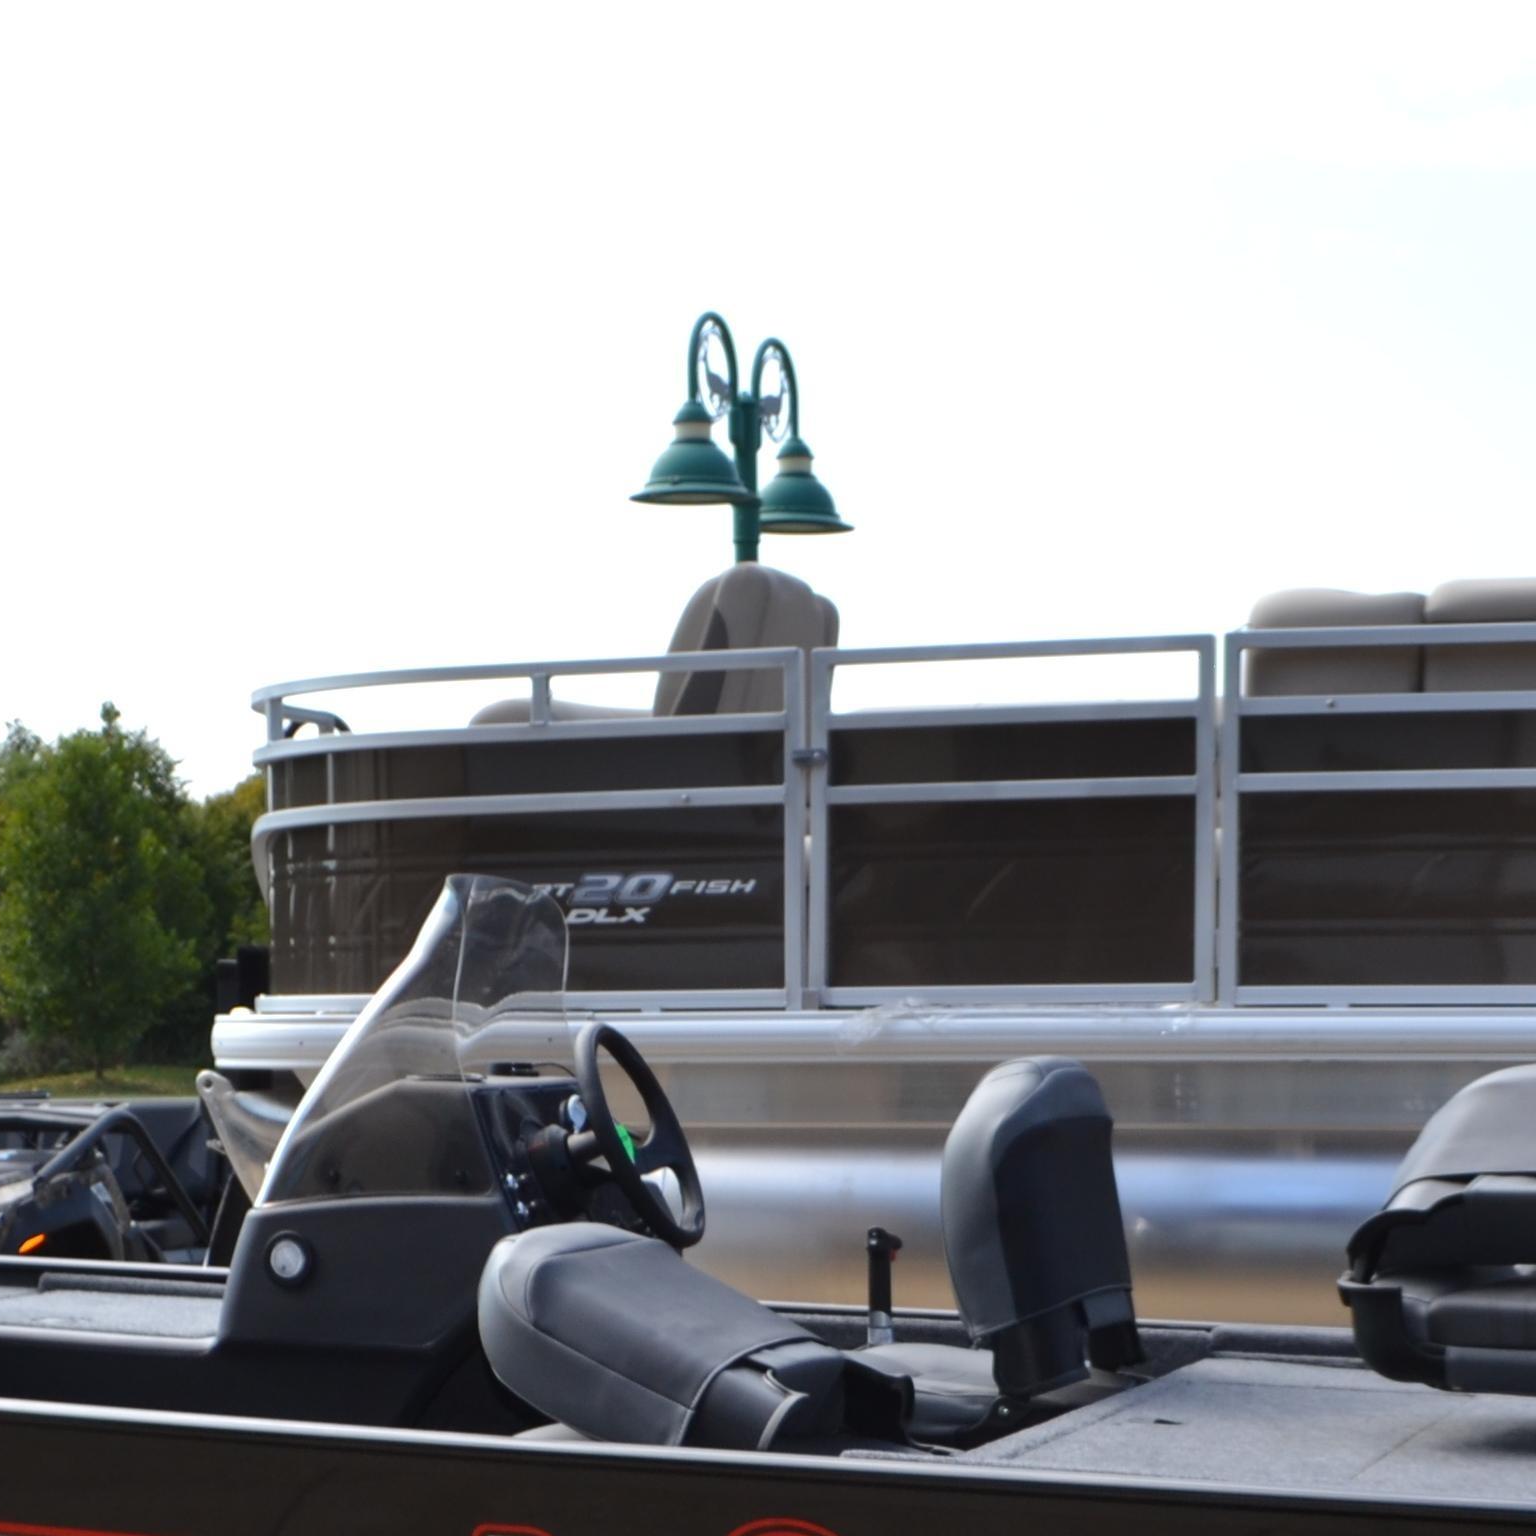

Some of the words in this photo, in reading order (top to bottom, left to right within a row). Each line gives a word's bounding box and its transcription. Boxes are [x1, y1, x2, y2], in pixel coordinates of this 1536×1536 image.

[568, 872, 674, 904] 20
[669, 878, 758, 897] FISH
[565, 907, 651, 925] DLX
